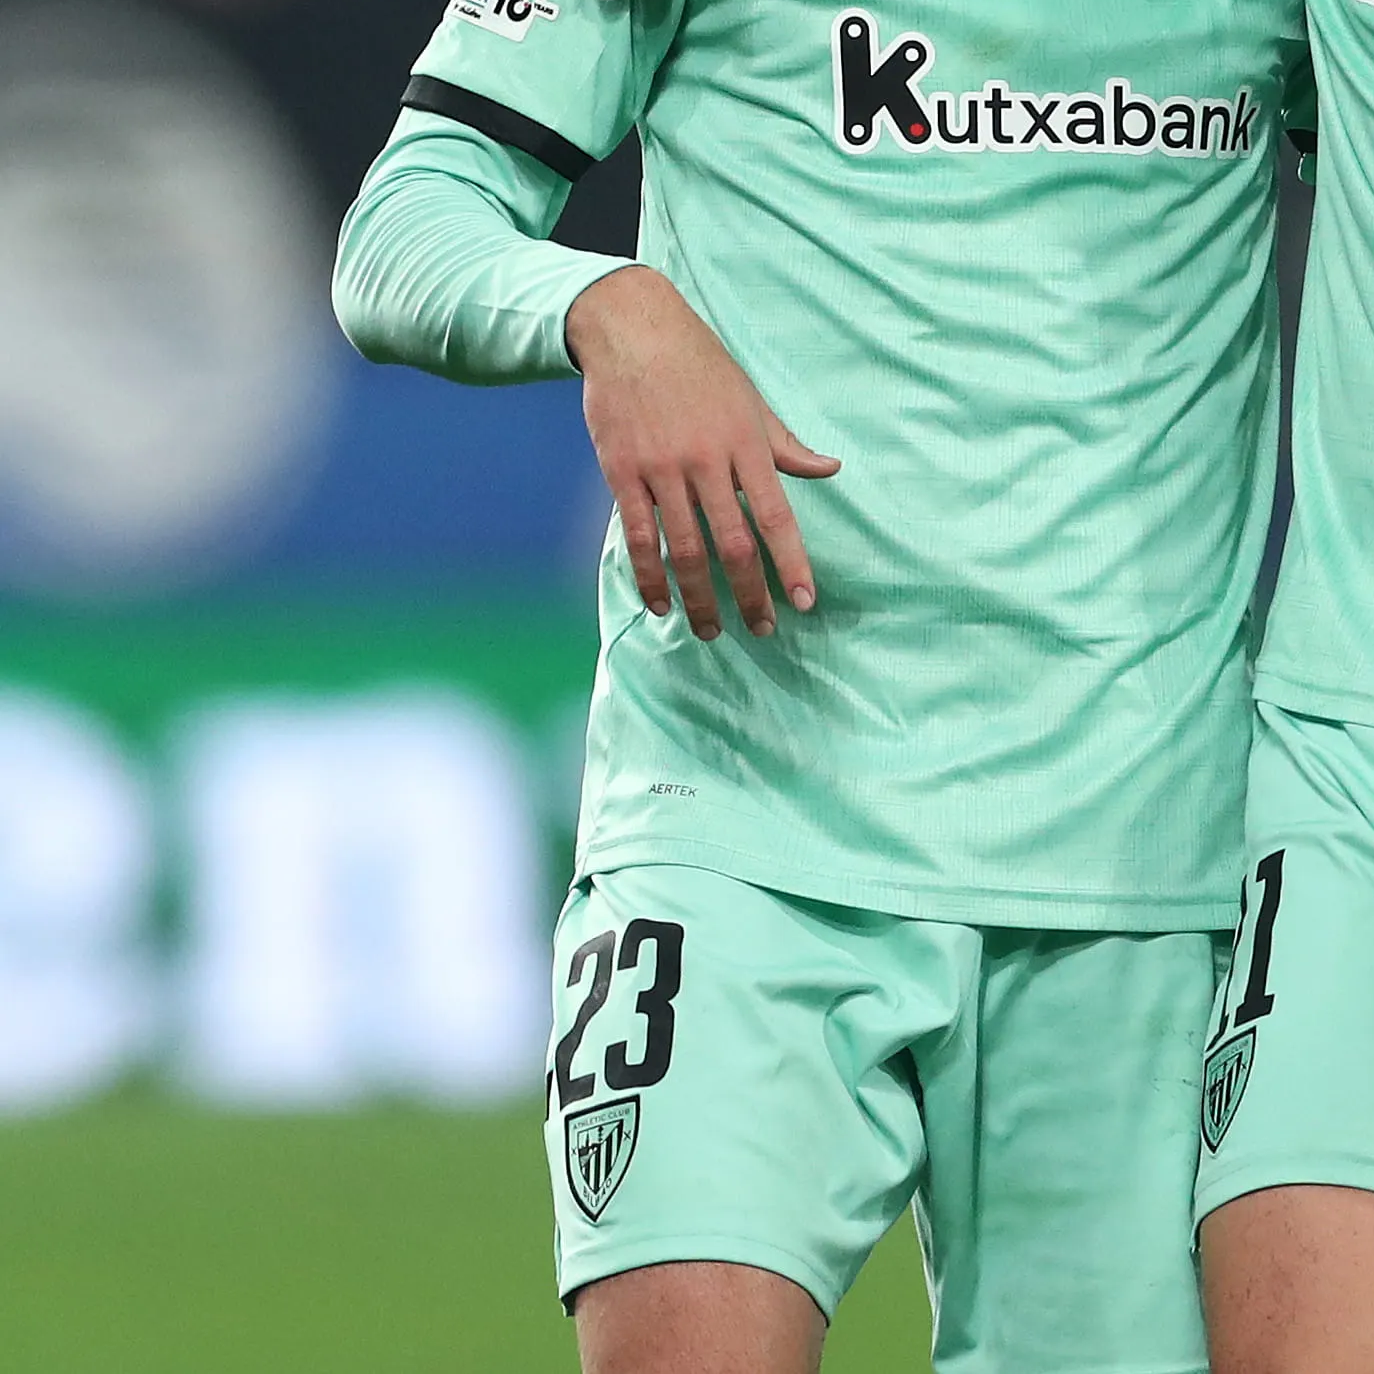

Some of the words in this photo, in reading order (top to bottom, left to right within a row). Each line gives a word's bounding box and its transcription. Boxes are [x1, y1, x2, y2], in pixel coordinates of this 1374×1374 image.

[840, 16, 1261, 152] Kutxabank
[648, 783, 699, 798] AERTEK
[555, 918, 685, 1111] 23
